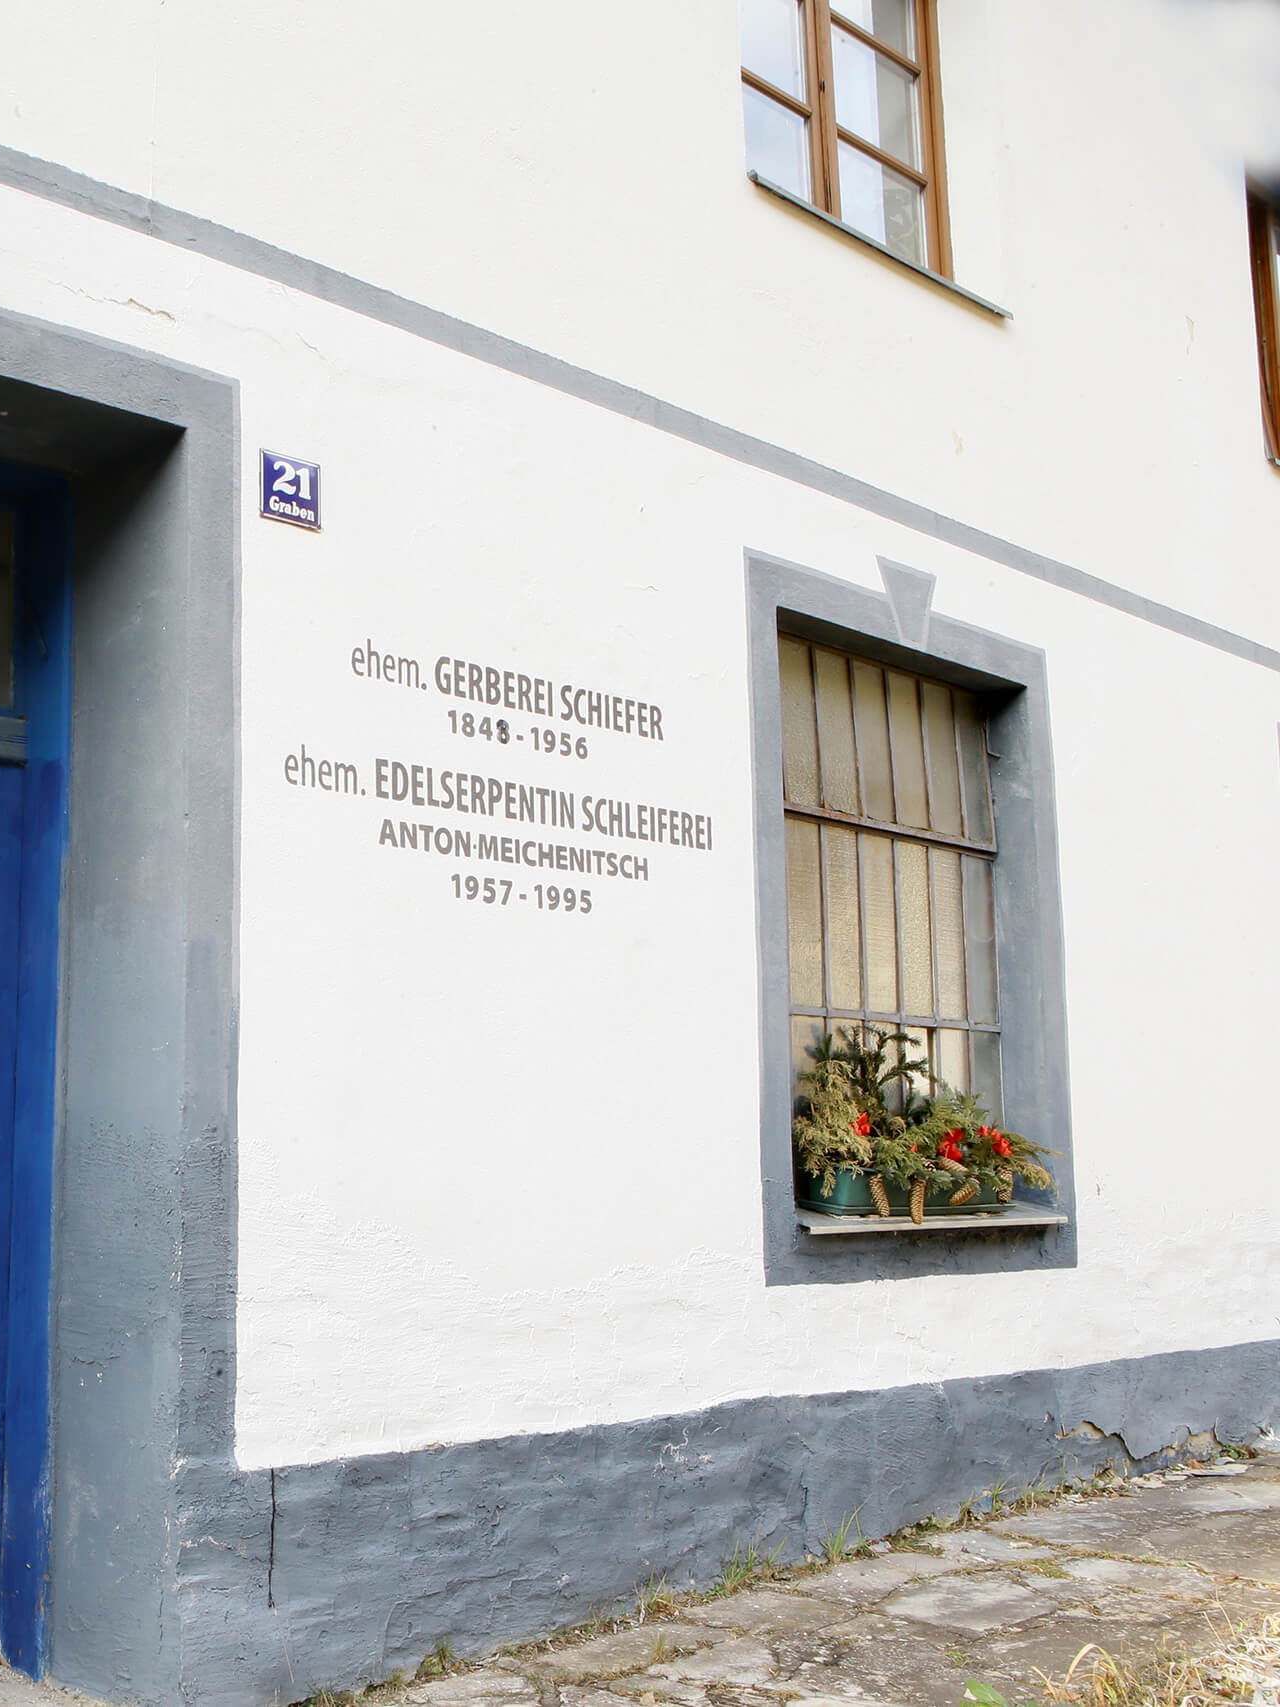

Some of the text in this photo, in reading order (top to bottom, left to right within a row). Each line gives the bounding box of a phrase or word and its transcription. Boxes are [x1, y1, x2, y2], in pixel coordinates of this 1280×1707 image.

[269, 496, 315, 522] Graben
[272, 461, 312, 500] 21
[351, 638, 664, 741] ehem. GERBEREI SCHIEFER
[284, 743, 713, 851] ehem. EDELSERPENTIN SCHLEIFEREI
